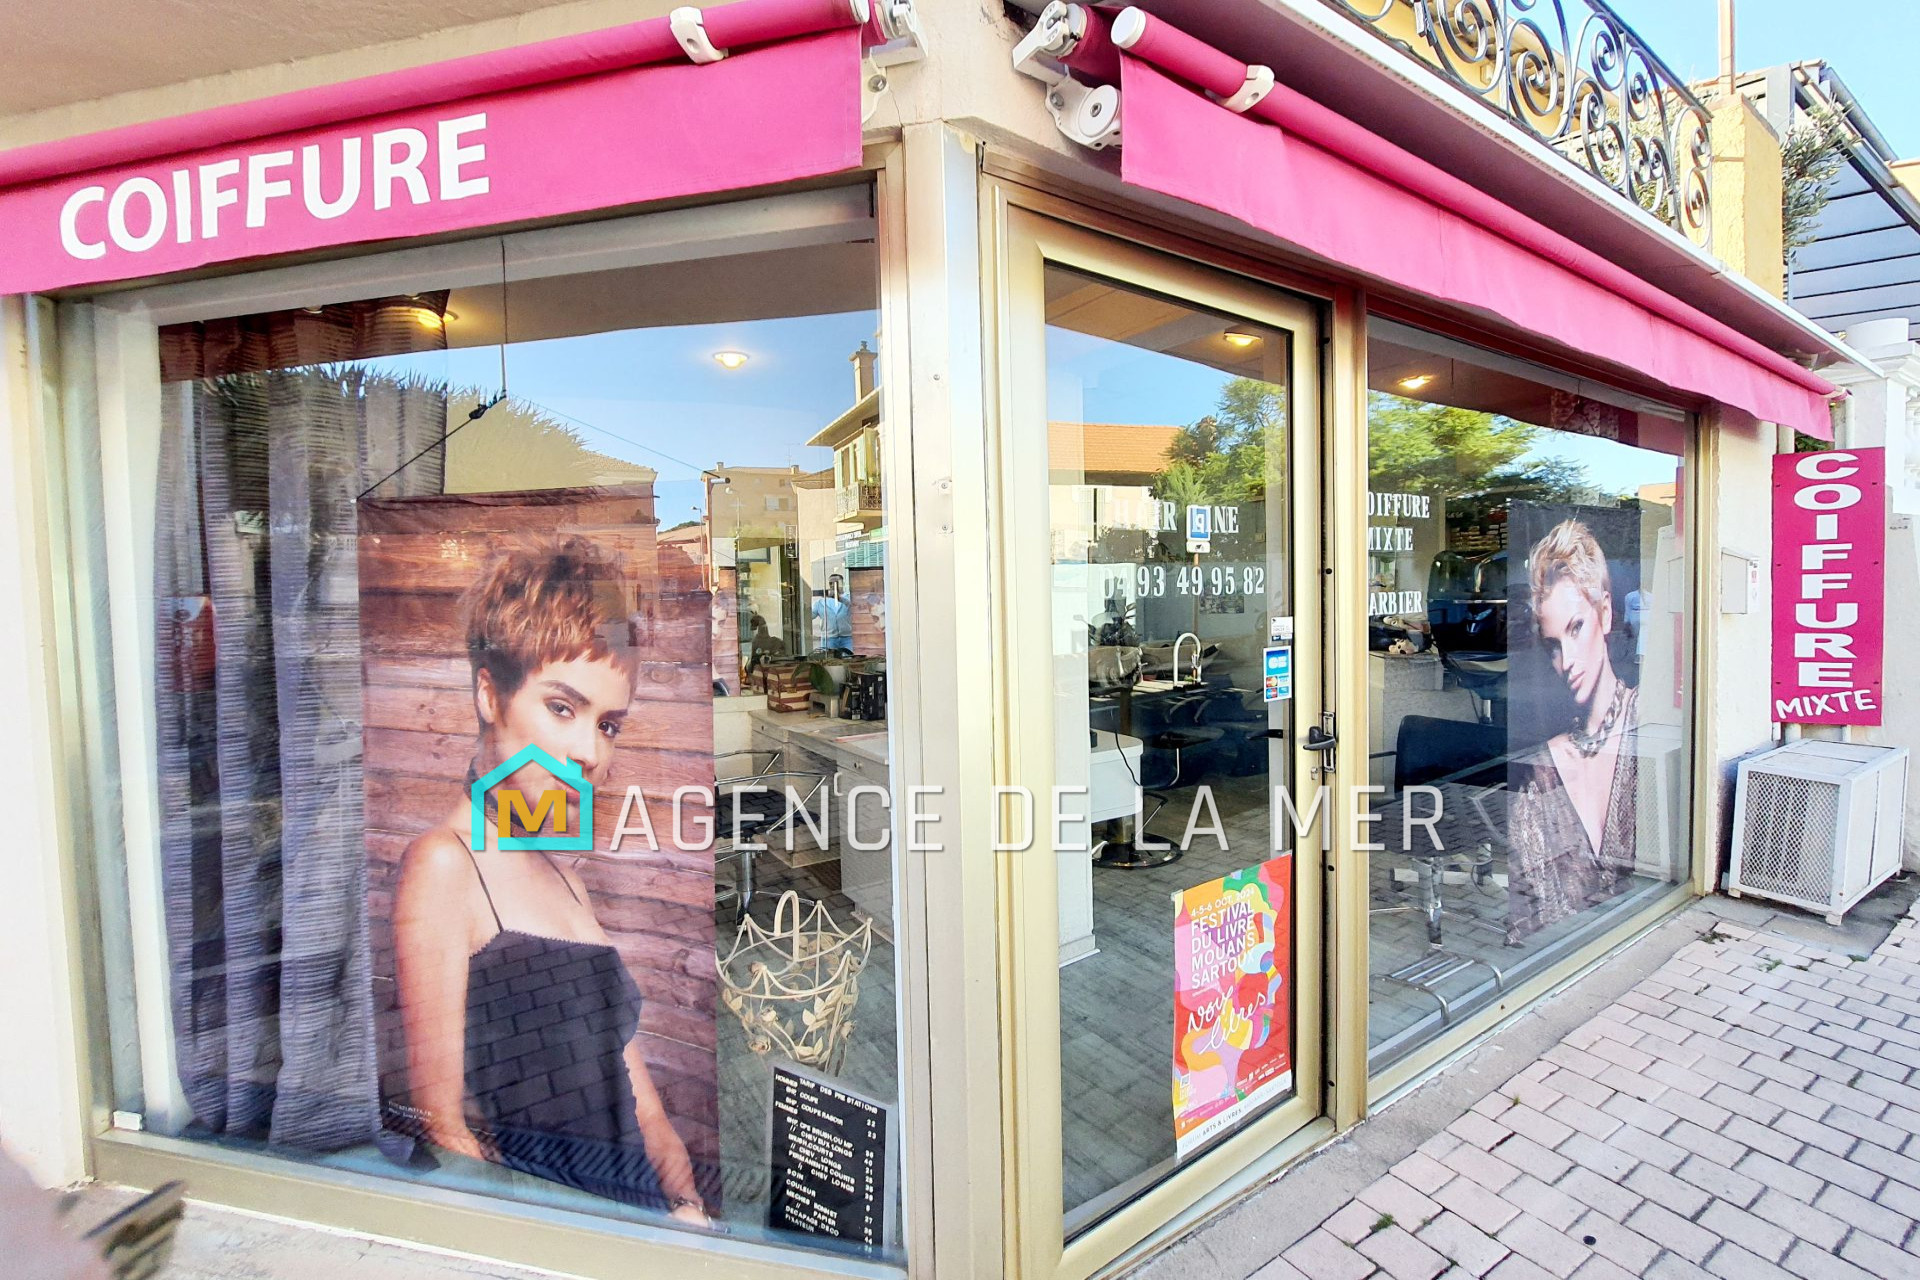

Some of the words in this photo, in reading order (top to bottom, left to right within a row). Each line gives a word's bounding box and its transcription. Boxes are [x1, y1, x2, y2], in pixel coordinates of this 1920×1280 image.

[58, 113, 489, 260] COIFFURE
[1367, 492, 1430, 518] OIFFURE
[1101, 565, 1128, 599] 04
[1137, 566, 1165, 597] 93
[1176, 566, 1204, 596] 49
[1211, 566, 1236, 595] 95
[1243, 566, 1265, 594] 82
[1793, 452, 1862, 688] COIFFURE
[1368, 591, 1422, 616] ARBIER
[1775, 689, 1877, 720] MIXTE
[1192, 902, 1212, 917] 4-5-6
[1192, 900, 1254, 936] FESTIVAL
[1192, 932, 1211, 954] DU
[1217, 915, 1254, 943] LIVRE
[1192, 932, 1255, 972] MOUANS
[1192, 952, 1254, 989] SARTOUX
[1198, 992, 1266, 1055] libres
[775, 1101, 798, 1114] FEMMES
[799, 1092, 819, 1104] COUPE
[801, 1104, 821, 1117] COUPE
[786, 1179, 816, 1197] COULEUR
[785, 1214, 814, 1233] FIXATEUR
[813, 1211, 836, 1227] PAPIER
